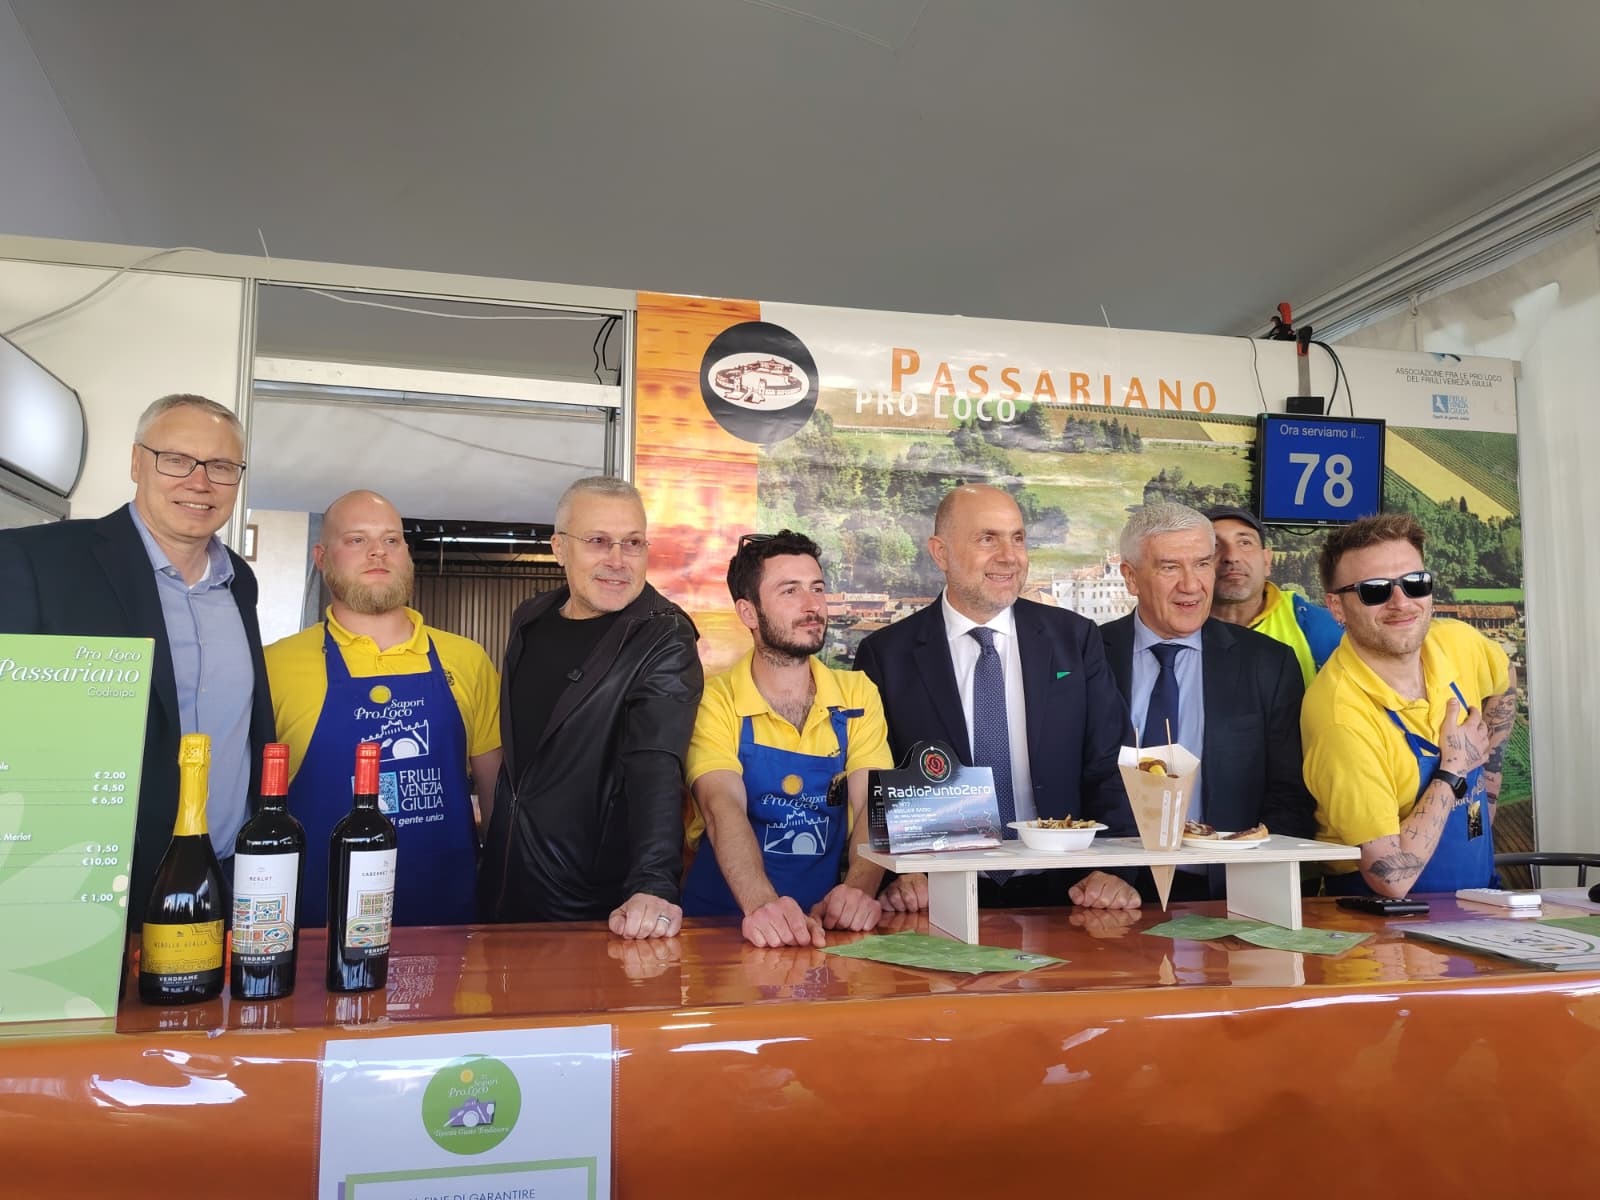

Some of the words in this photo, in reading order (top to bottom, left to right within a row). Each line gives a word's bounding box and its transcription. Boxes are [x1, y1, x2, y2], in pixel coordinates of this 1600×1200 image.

[891, 347, 1217, 414] PASSARIANO
[1395, 367, 1443, 378] ASSOCIAZIONE
[1445, 371, 1458, 379] FRA
[1485, 374, 1503, 382] LOCO
[1406, 375, 1419, 383] DEL
[1421, 376, 1442, 385] FRIULI
[1443, 377, 1471, 386] VENEZIA
[1472, 380, 1493, 388] GIULIA
[855, 390, 918, 417] PRO
[934, 391, 1017, 423] LOCO
[1280, 423, 1299, 436] Ora
[1302, 426, 1348, 439] serviamo
[1289, 452, 1354, 508] 78
[75, 646, 101, 660] Pro
[107, 647, 141, 663] Loco
[0, 657, 140, 683] Passariano
[390, 697, 425, 710] Sapori
[354, 707, 380, 720] Pro
[380, 707, 413, 720] Loco
[95, 771, 101, 779] €
[399, 768, 441, 785] FRIULI
[102, 784, 125, 792] 4,50
[400, 781, 444, 797] VENEZIA
[887, 784, 991, 799] RadioPuntoZero
[92, 796, 99, 804] €
[101, 796, 124, 805] 6,50
[401, 796, 444, 812] GIULIA
[761, 793, 787, 807] Pro
[398, 816, 424, 828] gente
[425, 812, 445, 823] unica
[4, 832, 31, 841] Merlot
[81, 894, 88, 902] €
[92, 893, 113, 902] 1,00
[160, 974, 199, 982] VENDRAME
[469, 1188, 536, 1200] GARANTIRE
